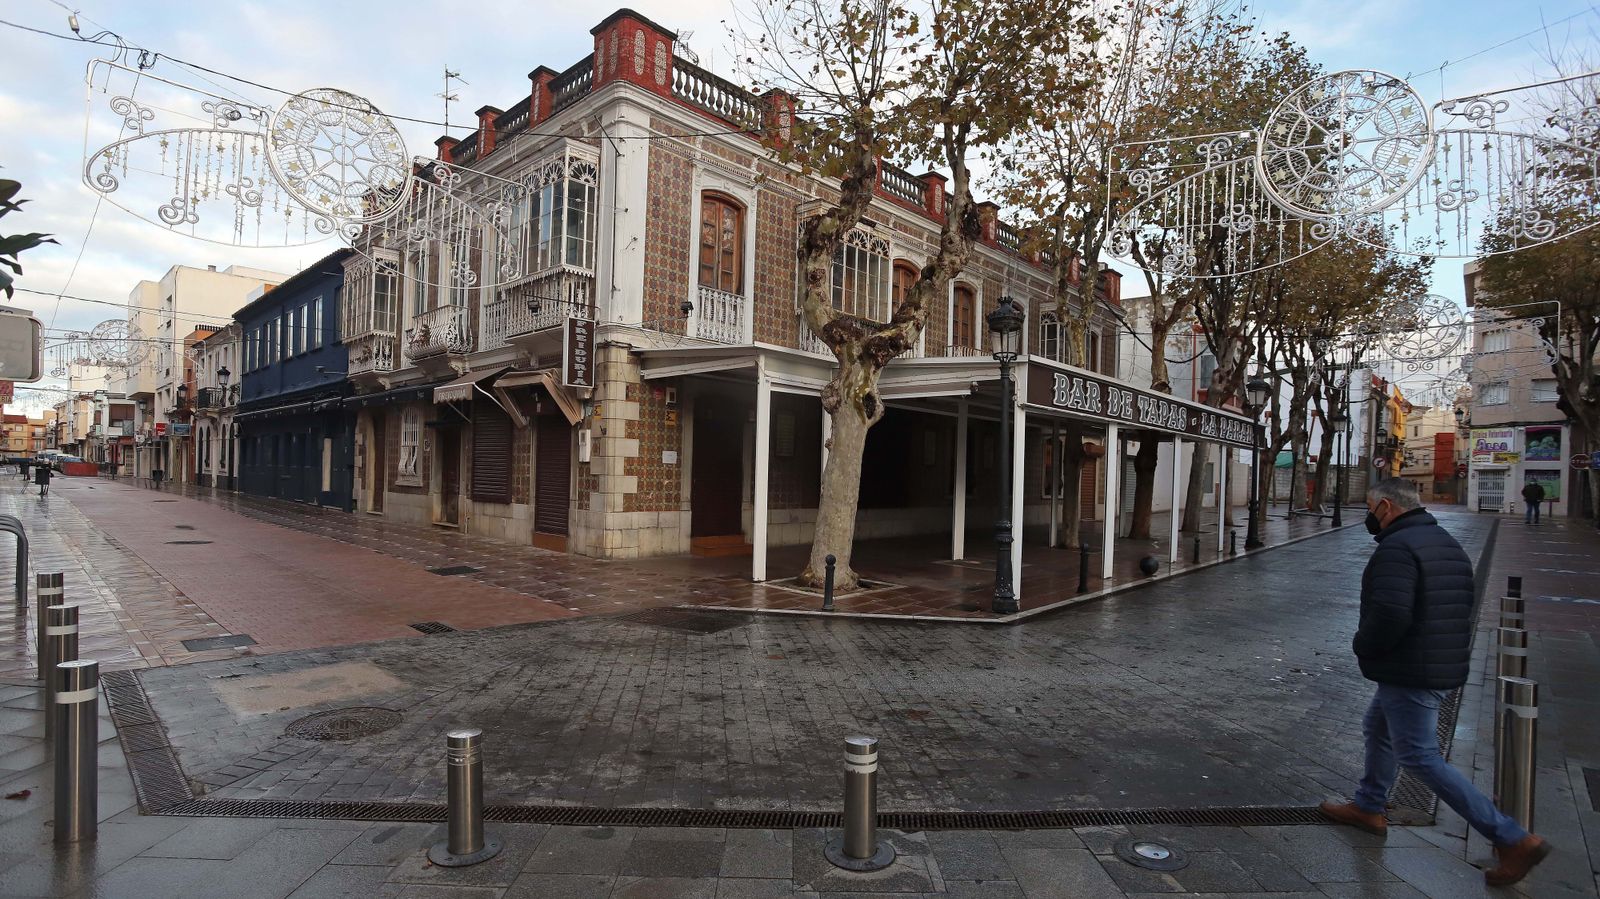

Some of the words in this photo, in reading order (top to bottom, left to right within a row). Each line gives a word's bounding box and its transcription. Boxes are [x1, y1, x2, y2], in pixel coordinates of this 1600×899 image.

[573, 320, 588, 385] FREIDURIA
[1053, 372, 1102, 413] BAR
[1107, 386, 1133, 420] DE
[1137, 394, 1188, 431] TAPAS
[1201, 412, 1218, 437] LA
[1220, 417, 1257, 446] PARAD
